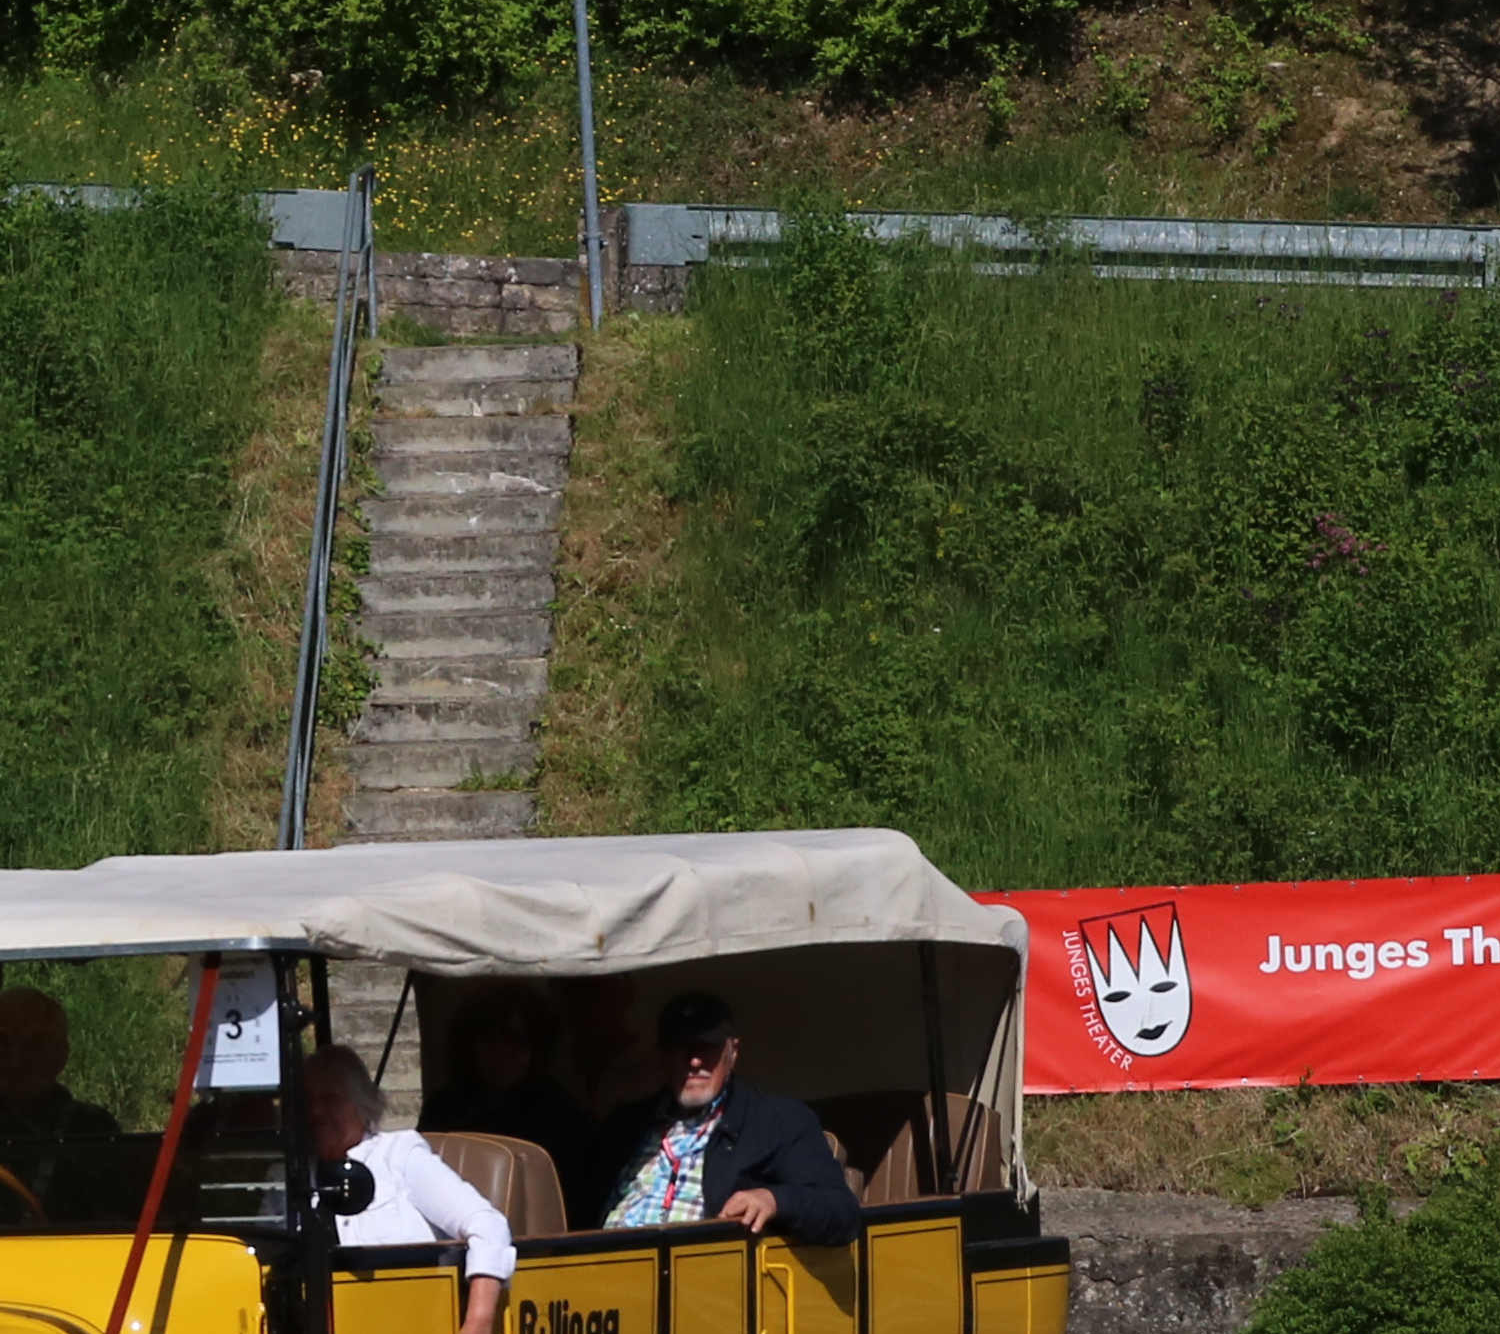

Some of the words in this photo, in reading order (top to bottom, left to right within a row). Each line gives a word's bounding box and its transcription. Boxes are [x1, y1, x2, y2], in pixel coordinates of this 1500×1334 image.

[1260, 935, 1430, 980] Junges
[1062, 930, 1092, 998] JUNGES
[1080, 1001, 1134, 1072] THEATER
[225, 1009, 242, 1039] 3
